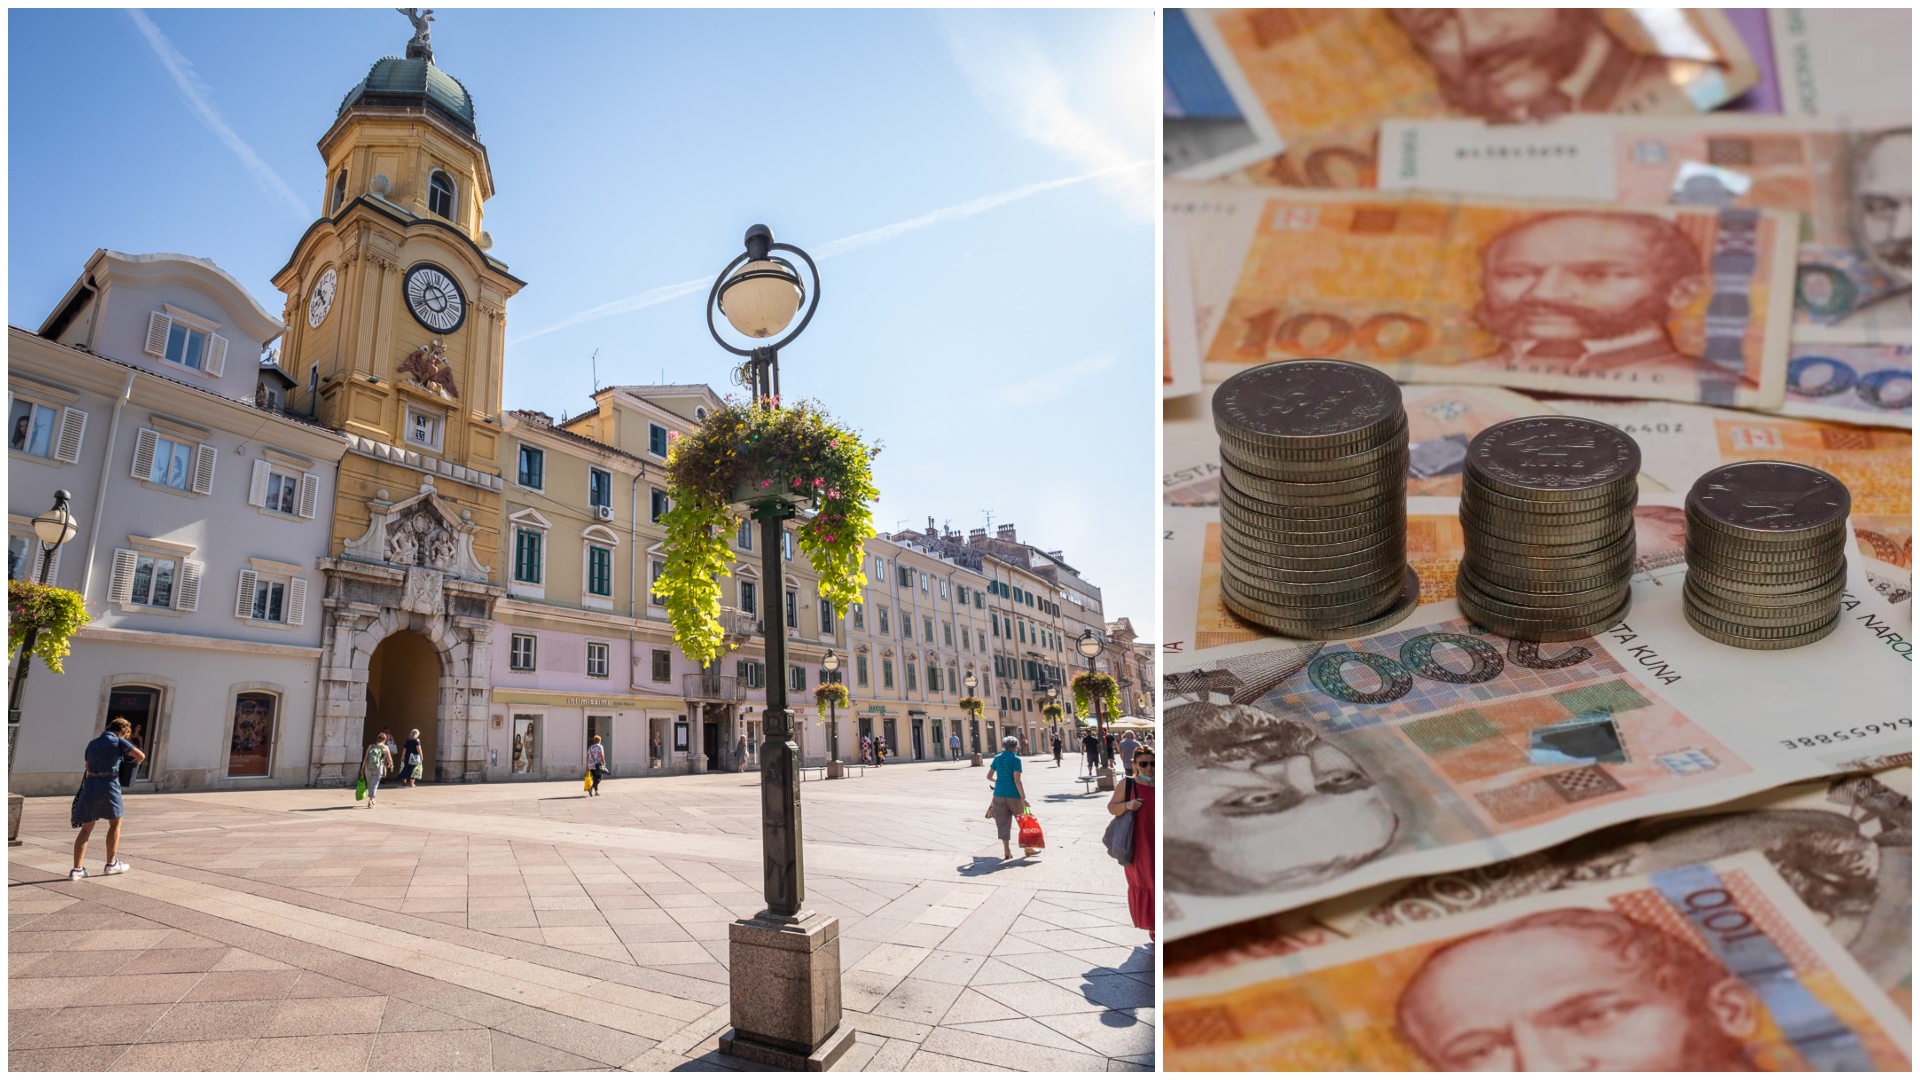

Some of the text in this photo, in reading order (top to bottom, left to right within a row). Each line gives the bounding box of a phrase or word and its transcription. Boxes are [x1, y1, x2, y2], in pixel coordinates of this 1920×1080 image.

[1233, 306, 1435, 359] 100
[1627, 645, 1682, 686] KUNA
[567, 698, 610, 706] intimissimi
[1684, 887, 1765, 944] 100
